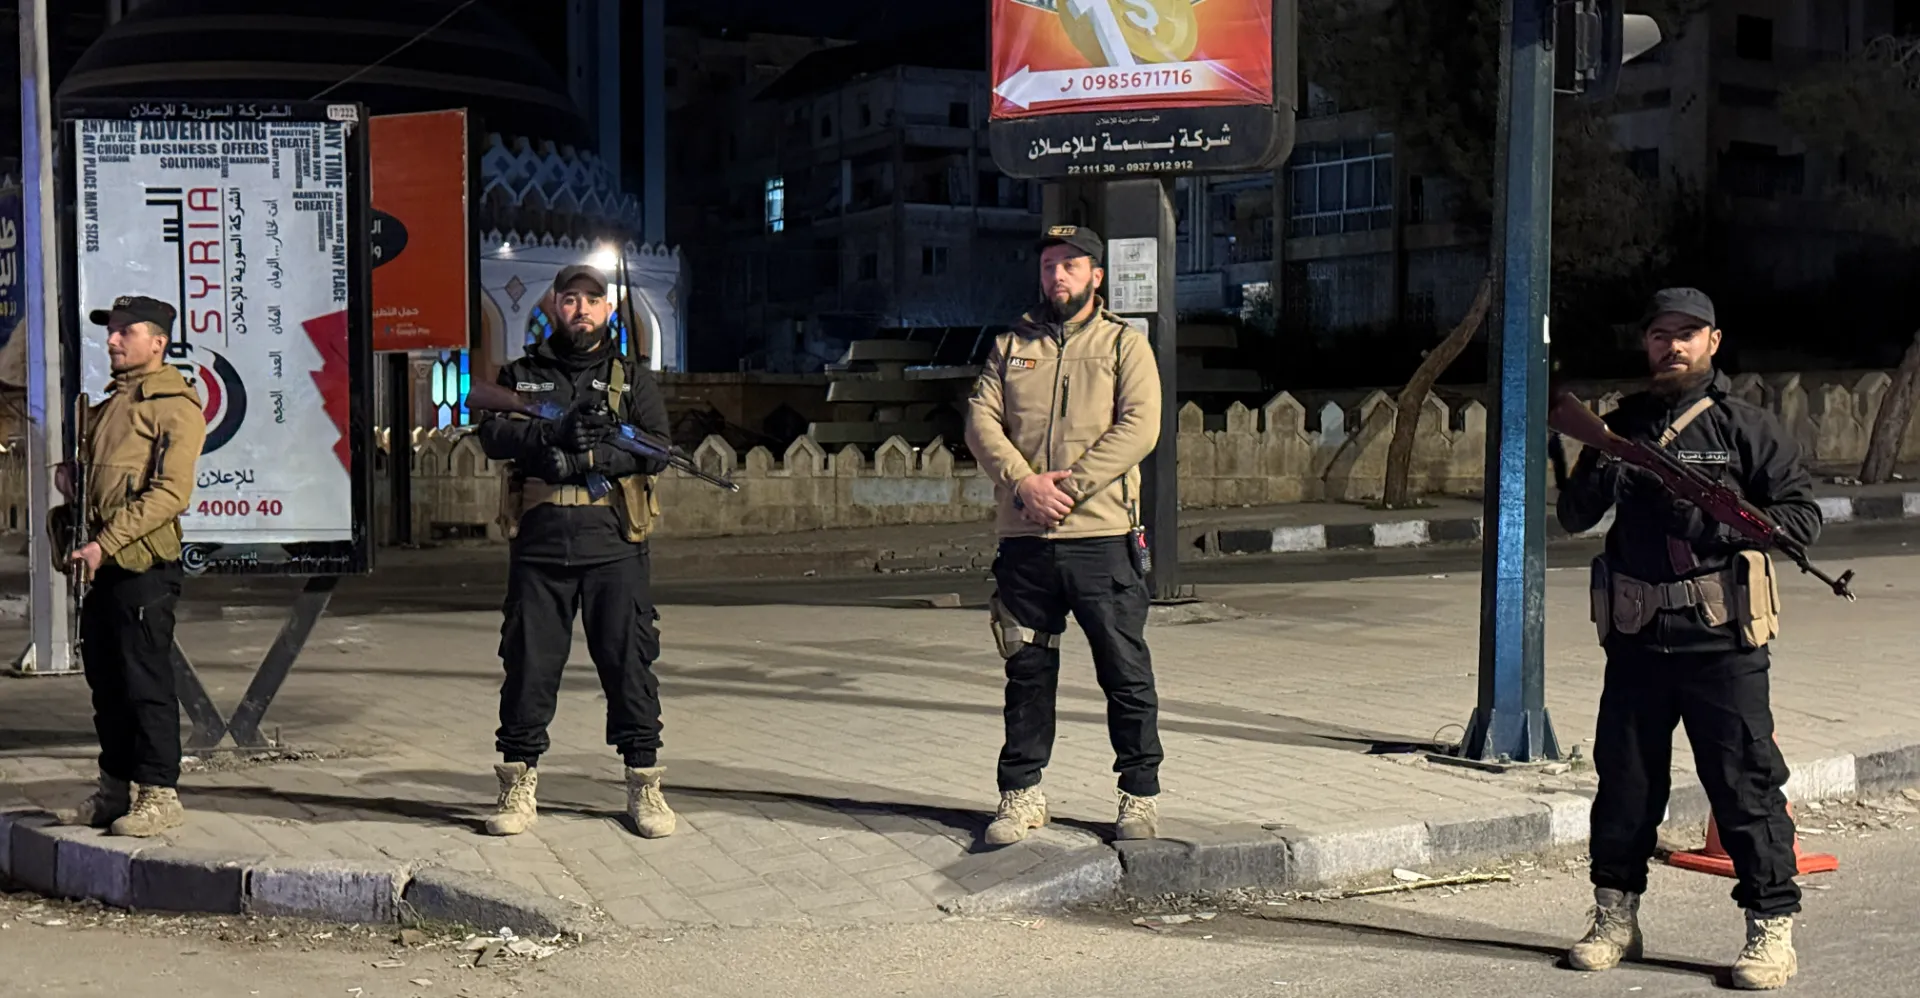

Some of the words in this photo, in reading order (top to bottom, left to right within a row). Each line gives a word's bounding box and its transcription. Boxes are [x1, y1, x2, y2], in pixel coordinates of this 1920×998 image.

[1082, 69, 1192, 91] 0985671716
[181, 104, 234, 119] السورية
[239, 104, 291, 120] الشركة
[83, 121, 105, 133] ANY
[108, 121, 137, 133] TIME
[140, 121, 267, 140] ADVERTISING
[270, 129, 311, 137] MARKETING
[324, 121, 342, 149] ANY
[1179, 123, 1231, 152] شركة
[83, 135, 96, 155] ANY
[97, 144, 136, 155] CHOICE
[140, 143, 217, 155] BUSINESS
[222, 142, 268, 155] OFFERS
[99, 134, 115, 143] ANY
[118, 134, 137, 143] SIZE
[272, 138, 311, 148] CREATE
[1028, 135, 1097, 160] للإعلان
[83, 157, 97, 189] PLACE
[160, 157, 221, 169] SOLUTIONS
[325, 152, 343, 188] TIME
[1067, 166, 1080, 175] 22
[1082, 164, 1100, 173] 111
[1103, 164, 1116, 173] 30
[1126, 162, 1151, 172] 0937
[1153, 161, 1172, 171] 912
[1174, 160, 1194, 170] 912
[84, 191, 98, 222] MANY
[228, 187, 245, 231] الشركة
[295, 201, 333, 212] CREATE
[85, 224, 99, 252] SIZES
[187, 187, 222, 334] SYRIA
[229, 234, 247, 283] السورية
[332, 245, 345, 266] ANY
[332, 268, 346, 303] PLACE
[231, 286, 248, 335] للإعلان
[267, 304, 283, 335] المكان
[269, 350, 283, 379] العدد
[269, 389, 286, 424] الحجم
[196, 469, 254, 490] للإعلان
[197, 500, 250, 516] 4000
[256, 500, 283, 516] 40
